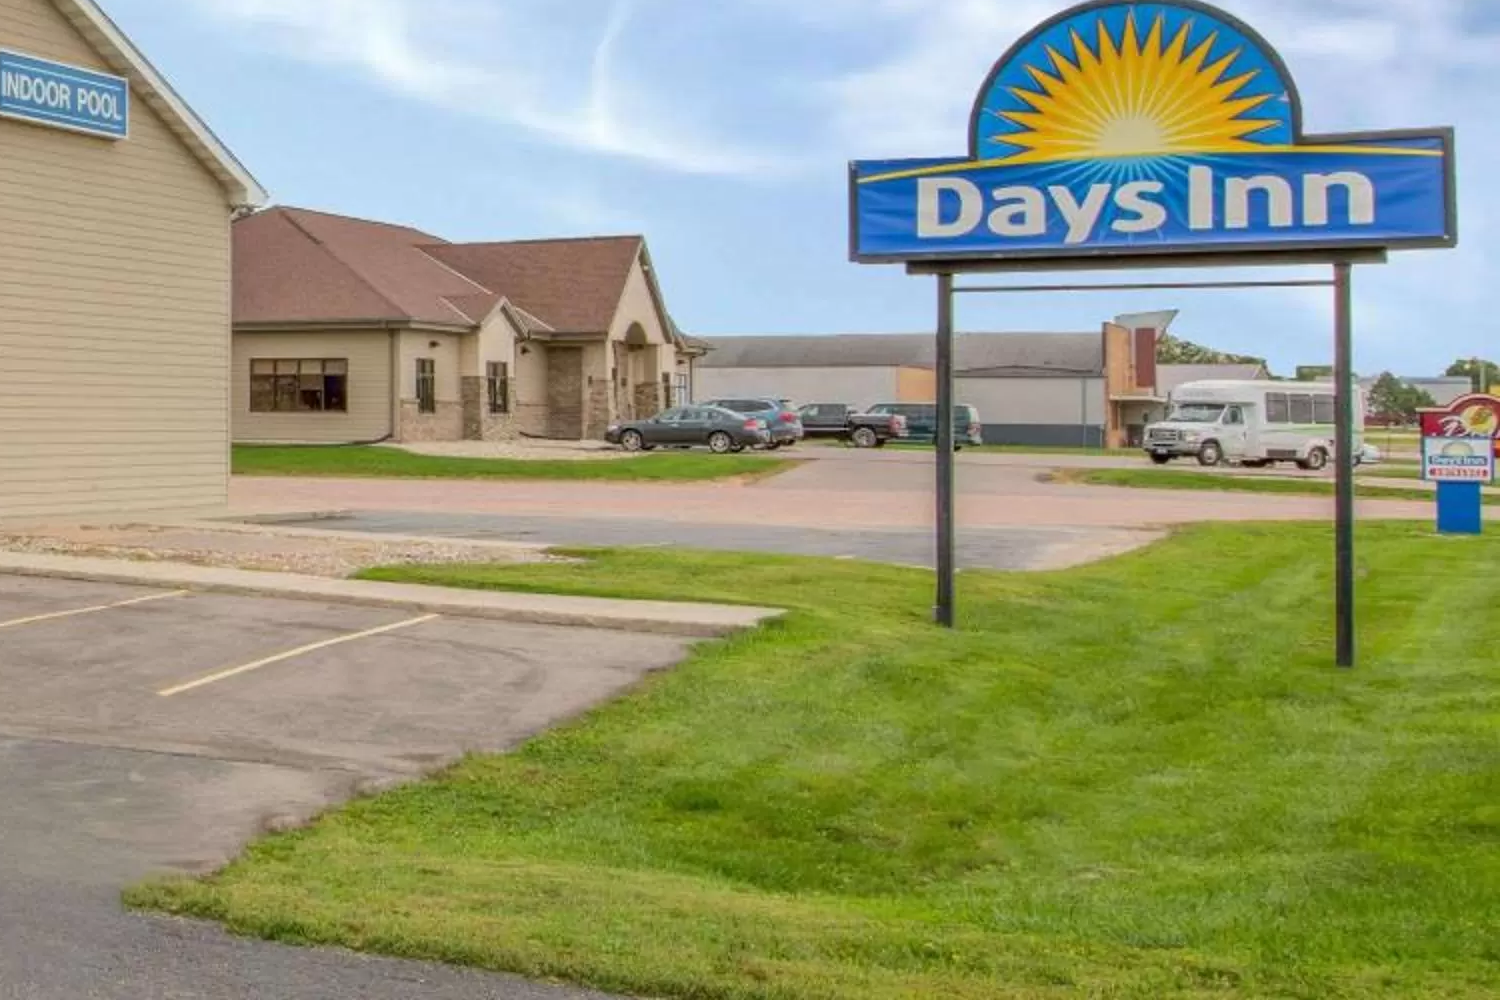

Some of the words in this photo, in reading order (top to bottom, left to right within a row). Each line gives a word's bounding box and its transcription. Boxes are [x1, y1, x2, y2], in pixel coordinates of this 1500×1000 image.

[2, 70, 71, 110] INDOOR
[77, 87, 122, 121] POOL
[916, 175, 1167, 245] Days
[1188, 165, 1375, 231] Inn
